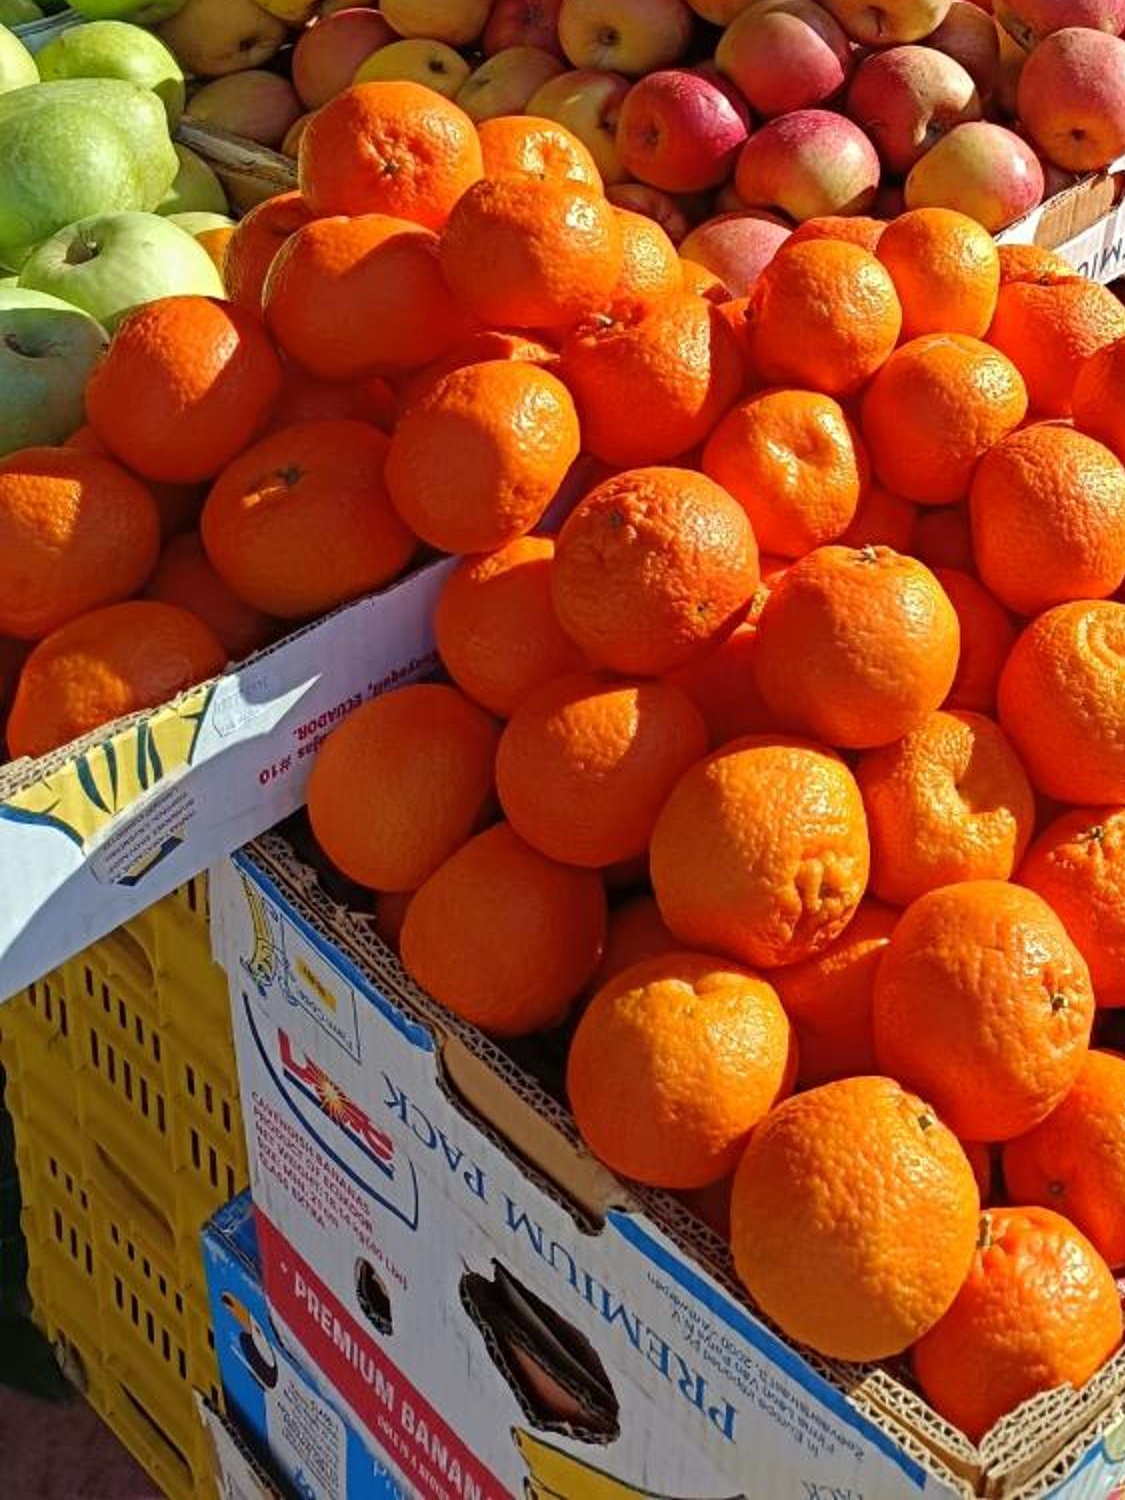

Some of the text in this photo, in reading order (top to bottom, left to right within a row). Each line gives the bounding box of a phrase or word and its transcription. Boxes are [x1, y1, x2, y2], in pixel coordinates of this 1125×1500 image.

[316, 1147, 371, 1216] BANANAS
[382, 1070, 738, 1444] PREMIUM PACK
[295, 1275, 394, 1413] PREMIUM
